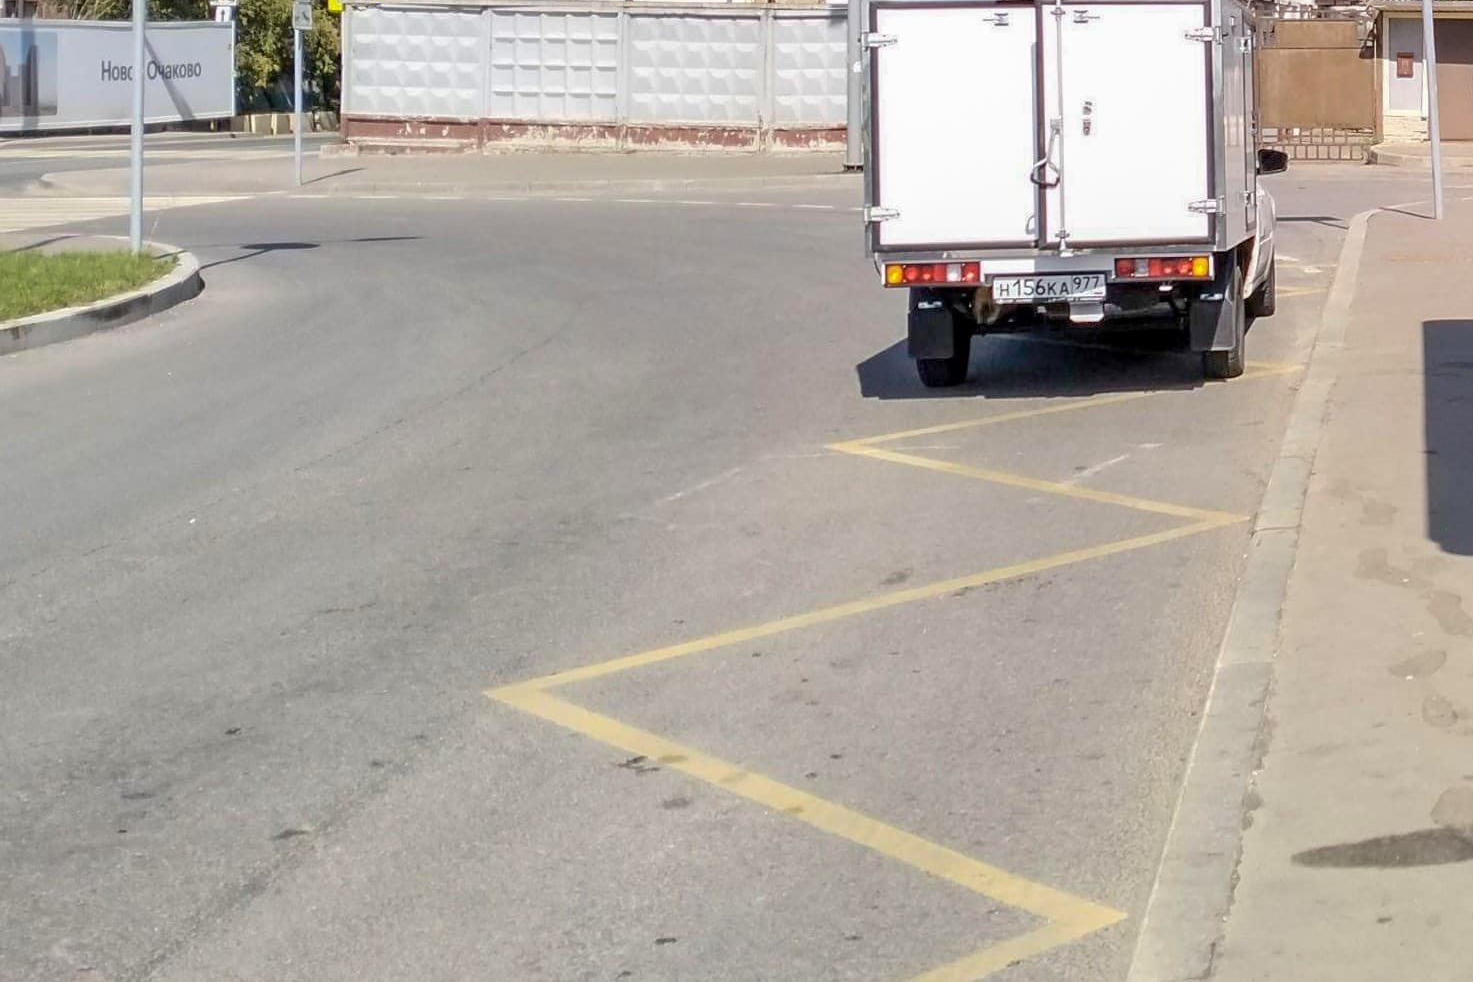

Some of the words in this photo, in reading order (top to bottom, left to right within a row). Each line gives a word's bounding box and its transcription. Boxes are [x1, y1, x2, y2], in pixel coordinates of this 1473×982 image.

[146, 60, 202, 80] Очаково
[999, 278, 1070, 297] Н156КА
[1072, 275, 1100, 294] 977
